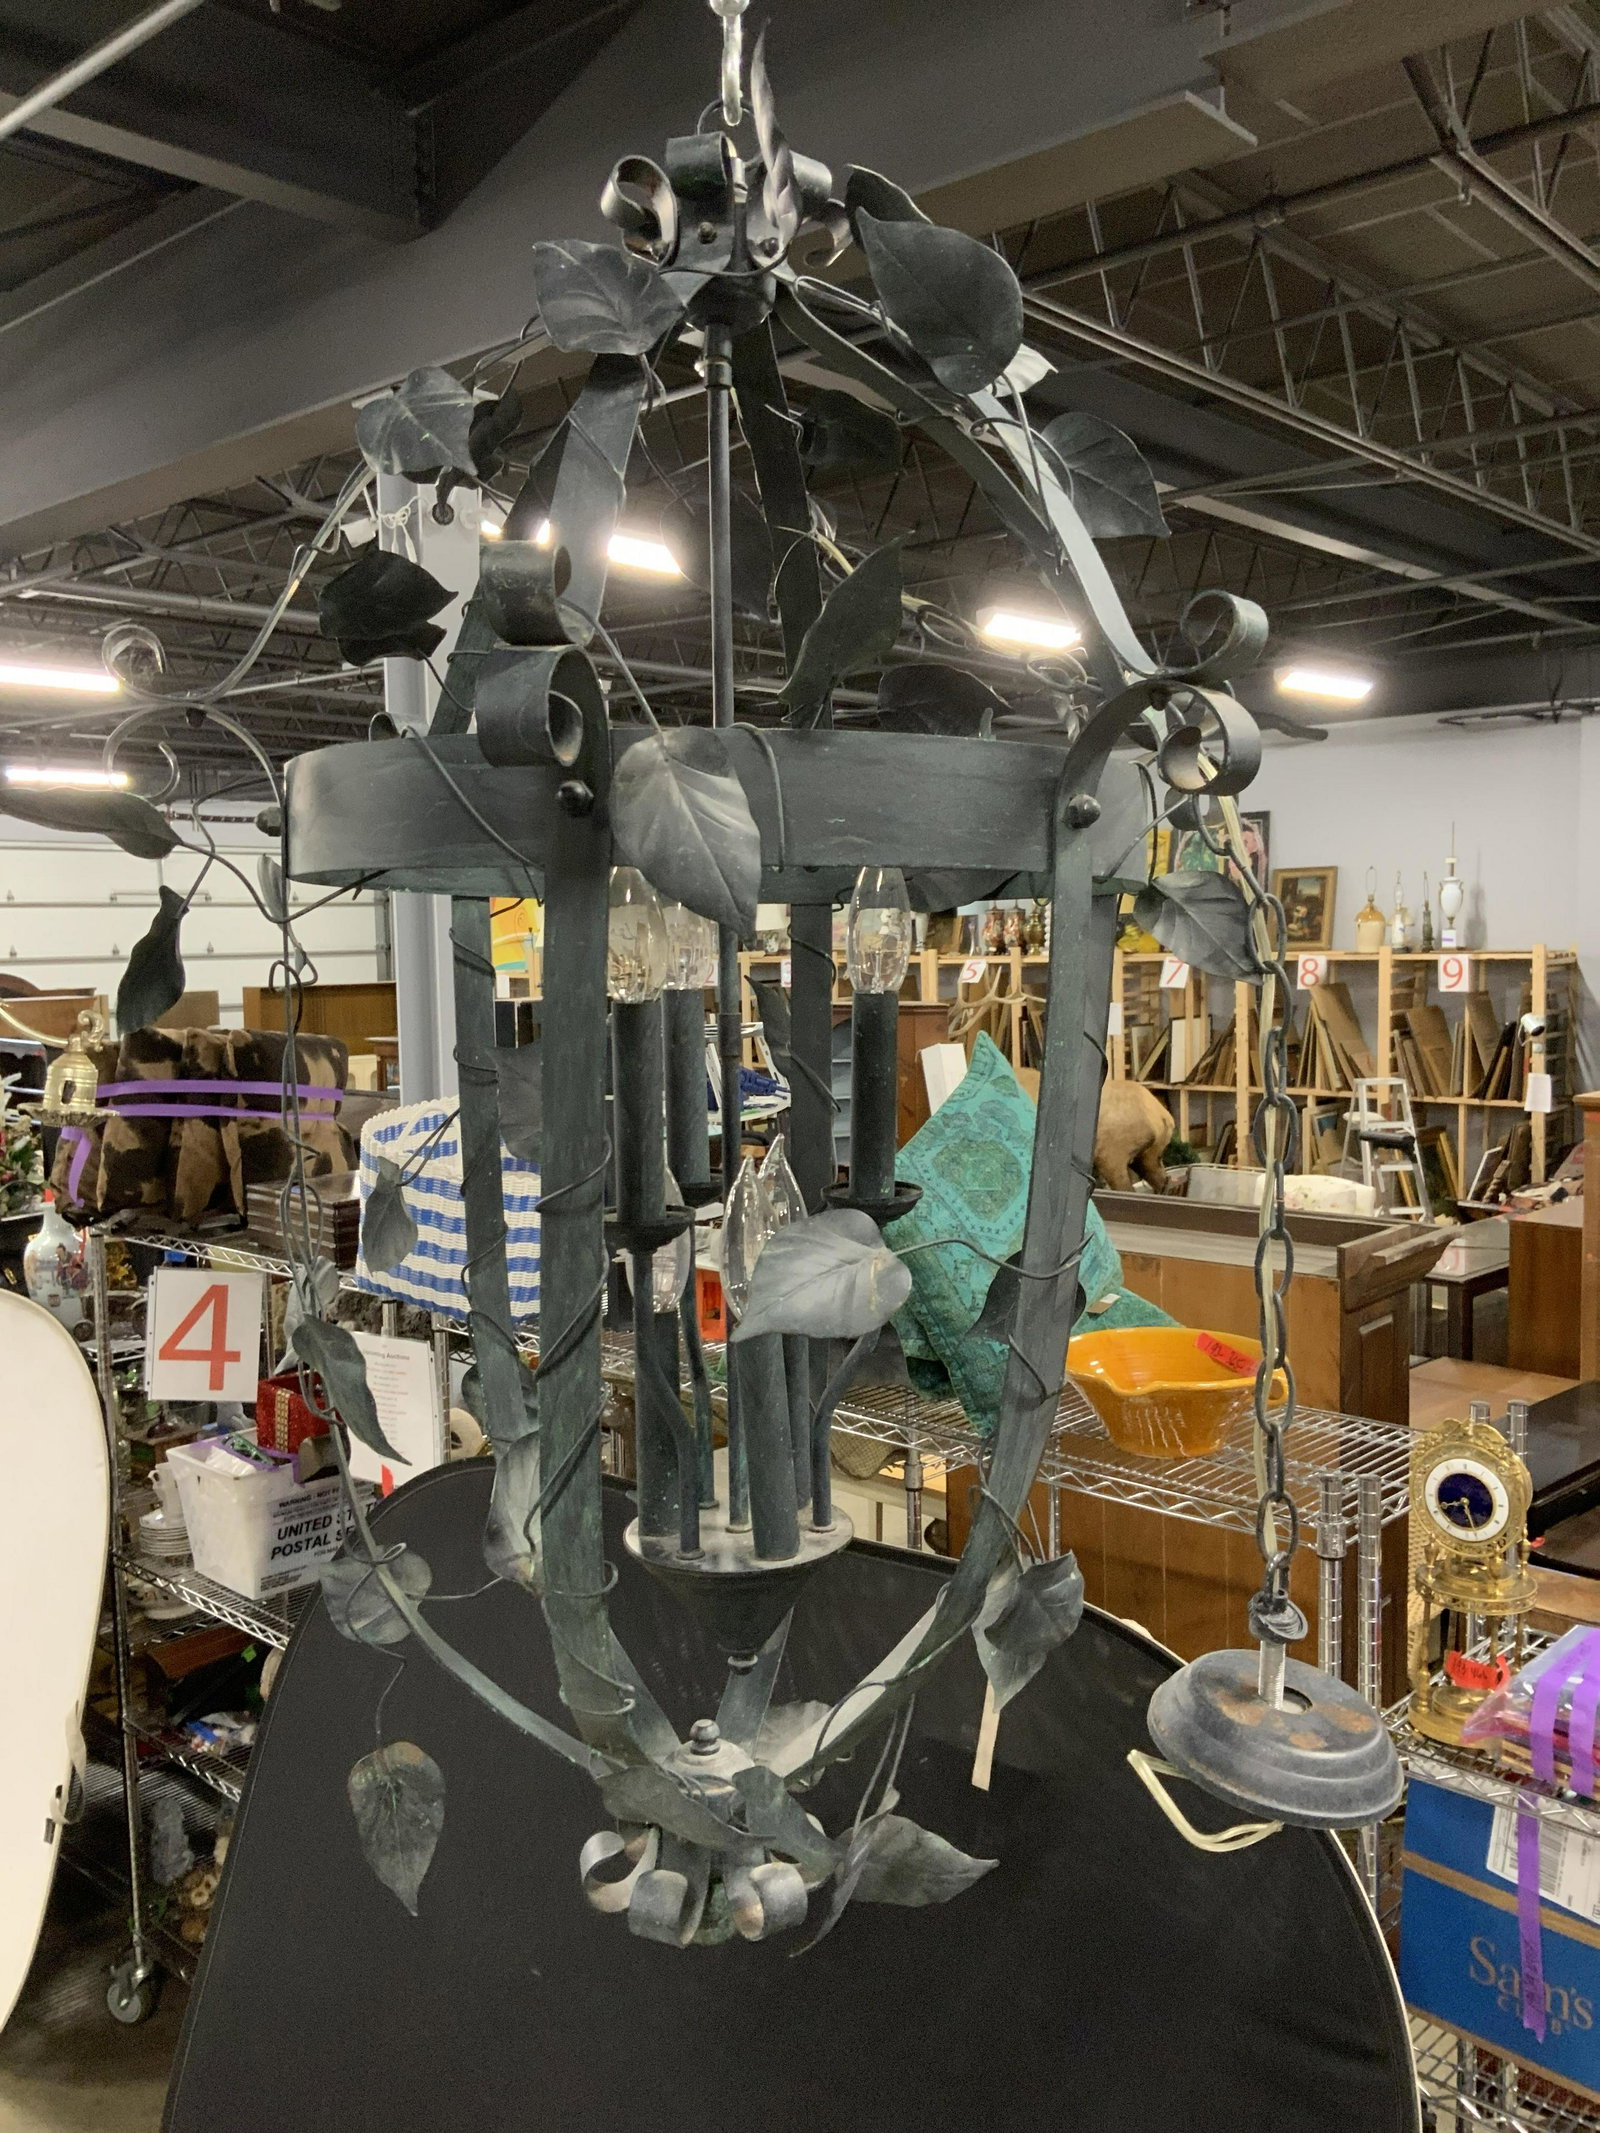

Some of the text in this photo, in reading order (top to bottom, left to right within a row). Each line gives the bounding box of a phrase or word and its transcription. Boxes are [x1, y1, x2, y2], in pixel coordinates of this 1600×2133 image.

[961, 961, 982, 981] 5
[1166, 959, 1184, 985] 7
[1299, 957, 1320, 988] 8
[1442, 957, 1464, 989] 9
[158, 1284, 242, 1391] 4
[276, 1514, 333, 1541] UNITED
[270, 1532, 332, 1561] POSTAL
